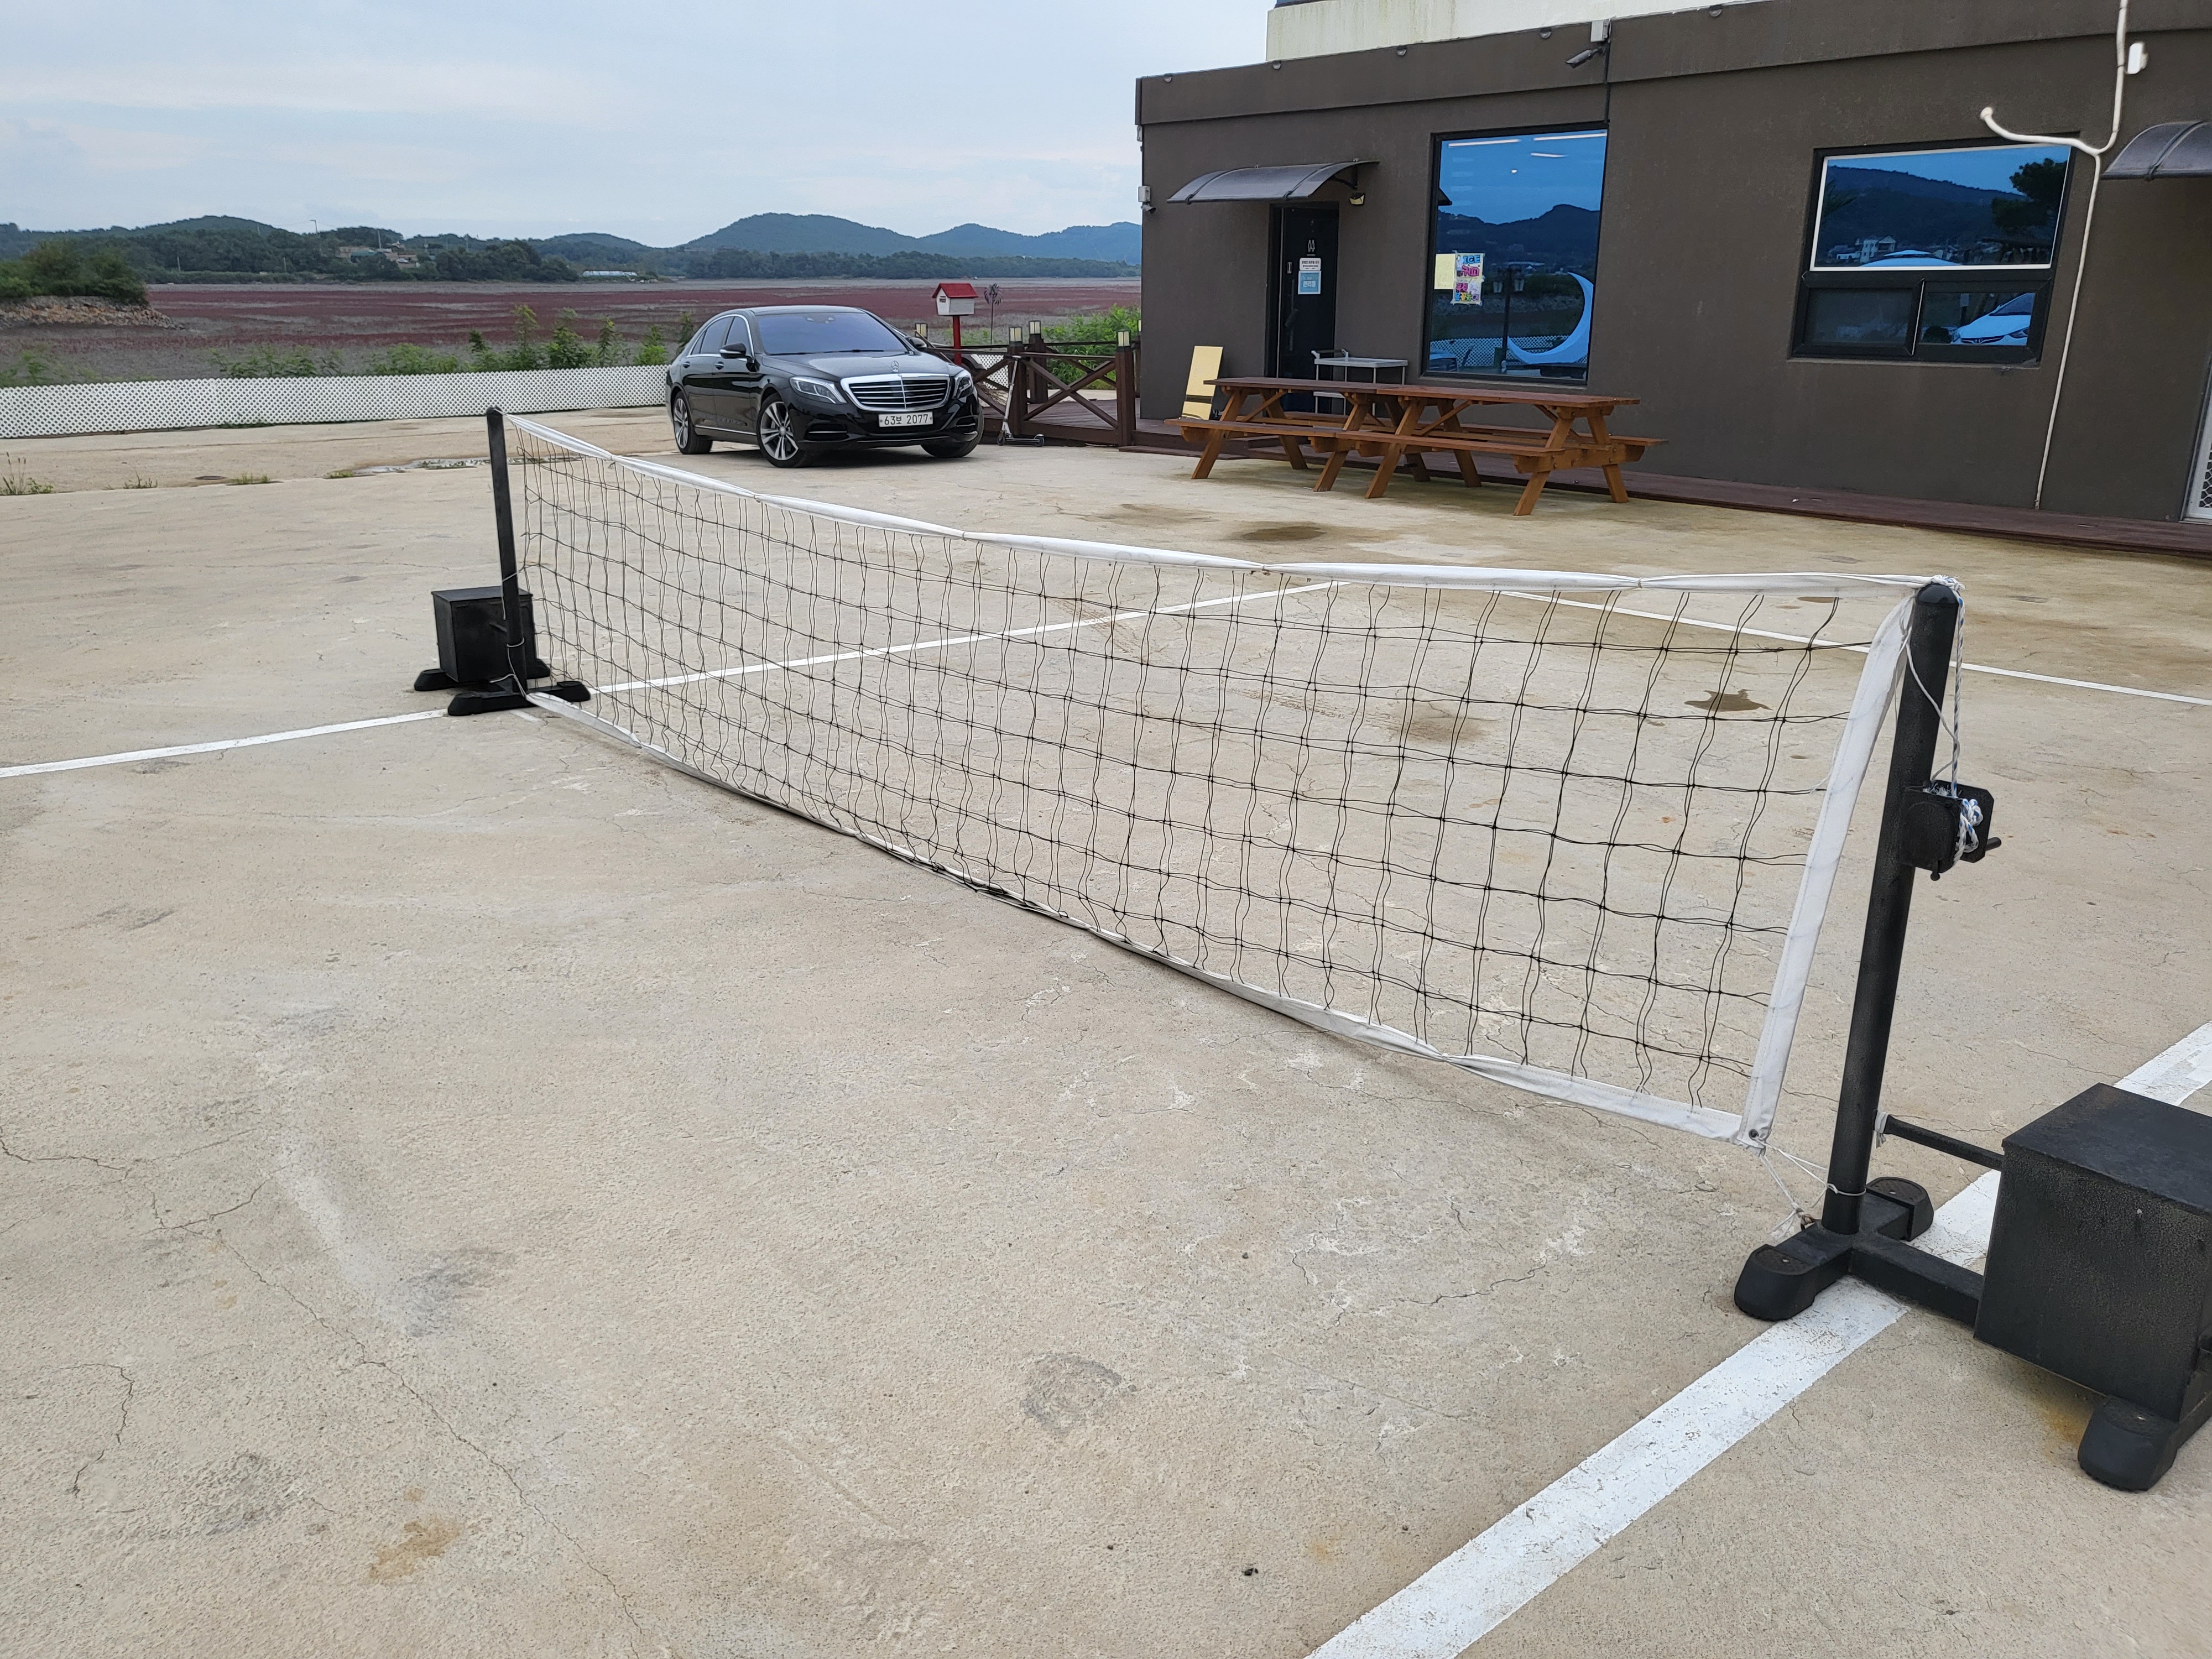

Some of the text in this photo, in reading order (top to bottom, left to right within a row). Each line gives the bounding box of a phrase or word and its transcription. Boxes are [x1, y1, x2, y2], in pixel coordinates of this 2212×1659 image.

[1463, 255, 1480, 264] ICE
[1462, 265, 1480, 276] 커피
[884, 414, 928, 425] 63보 2077
